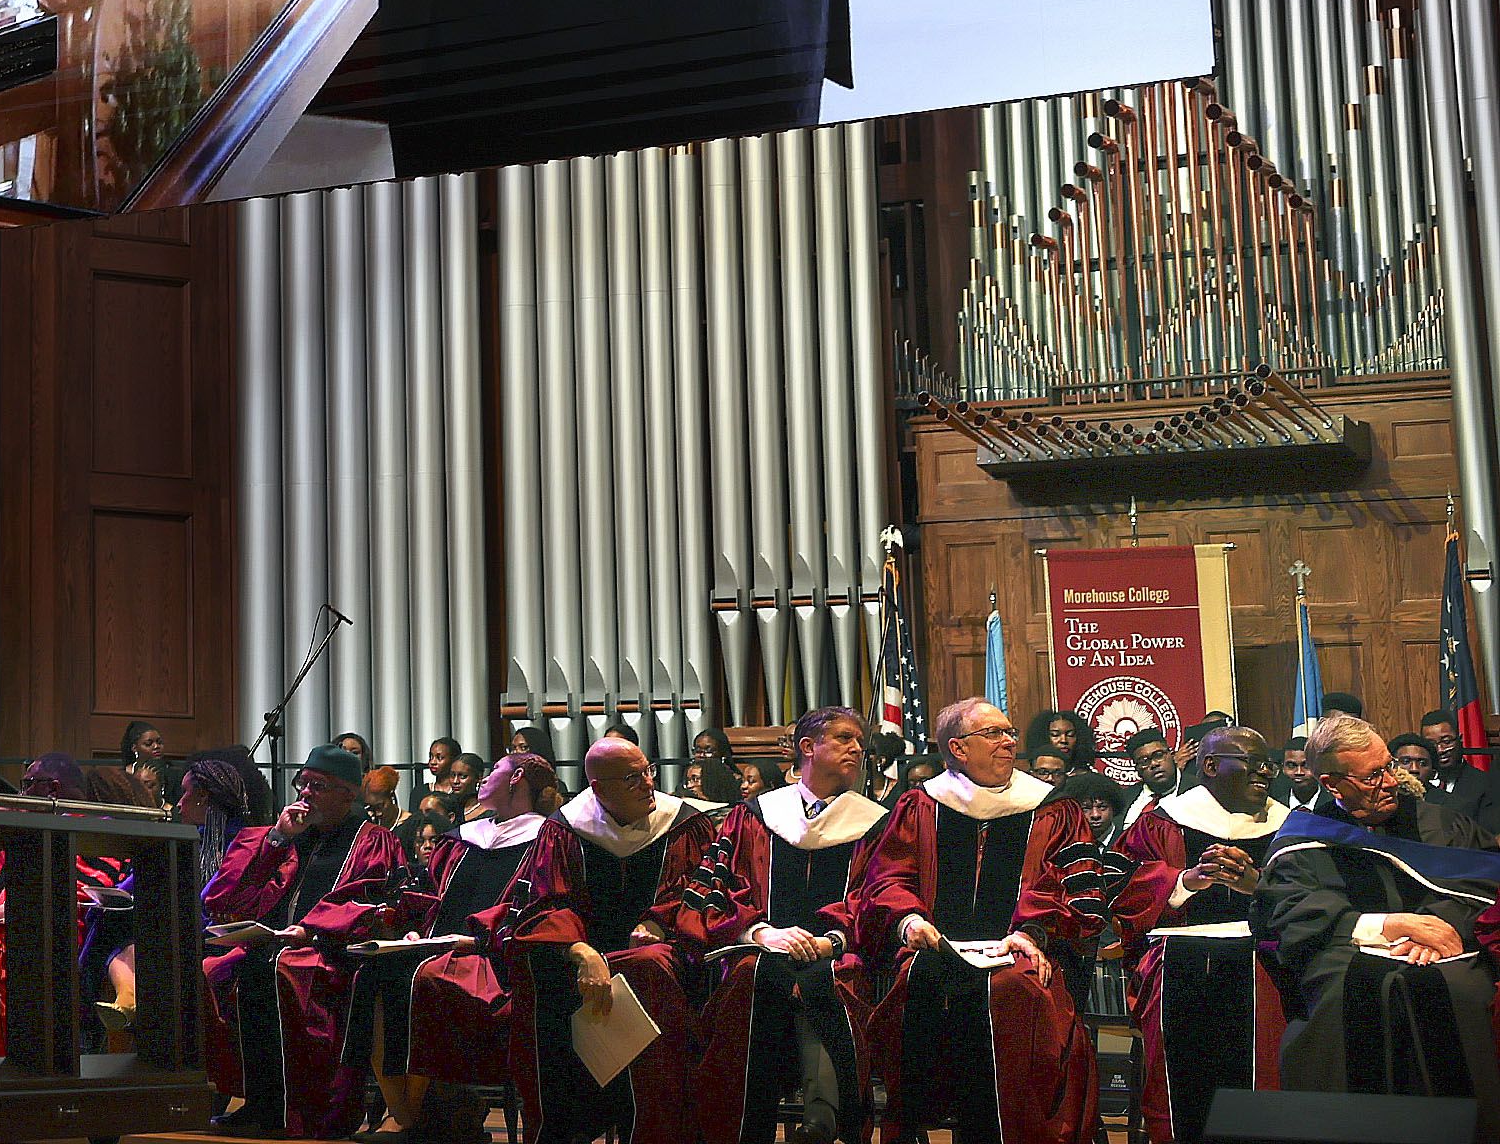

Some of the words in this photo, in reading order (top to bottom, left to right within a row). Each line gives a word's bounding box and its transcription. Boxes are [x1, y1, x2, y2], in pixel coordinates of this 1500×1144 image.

[1063, 588, 1126, 604] Morehouse
[1128, 586, 1170, 604] College
[1078, 680, 1133, 720] OREHOUSE
[1134, 683, 1176, 729] COLLEGE
